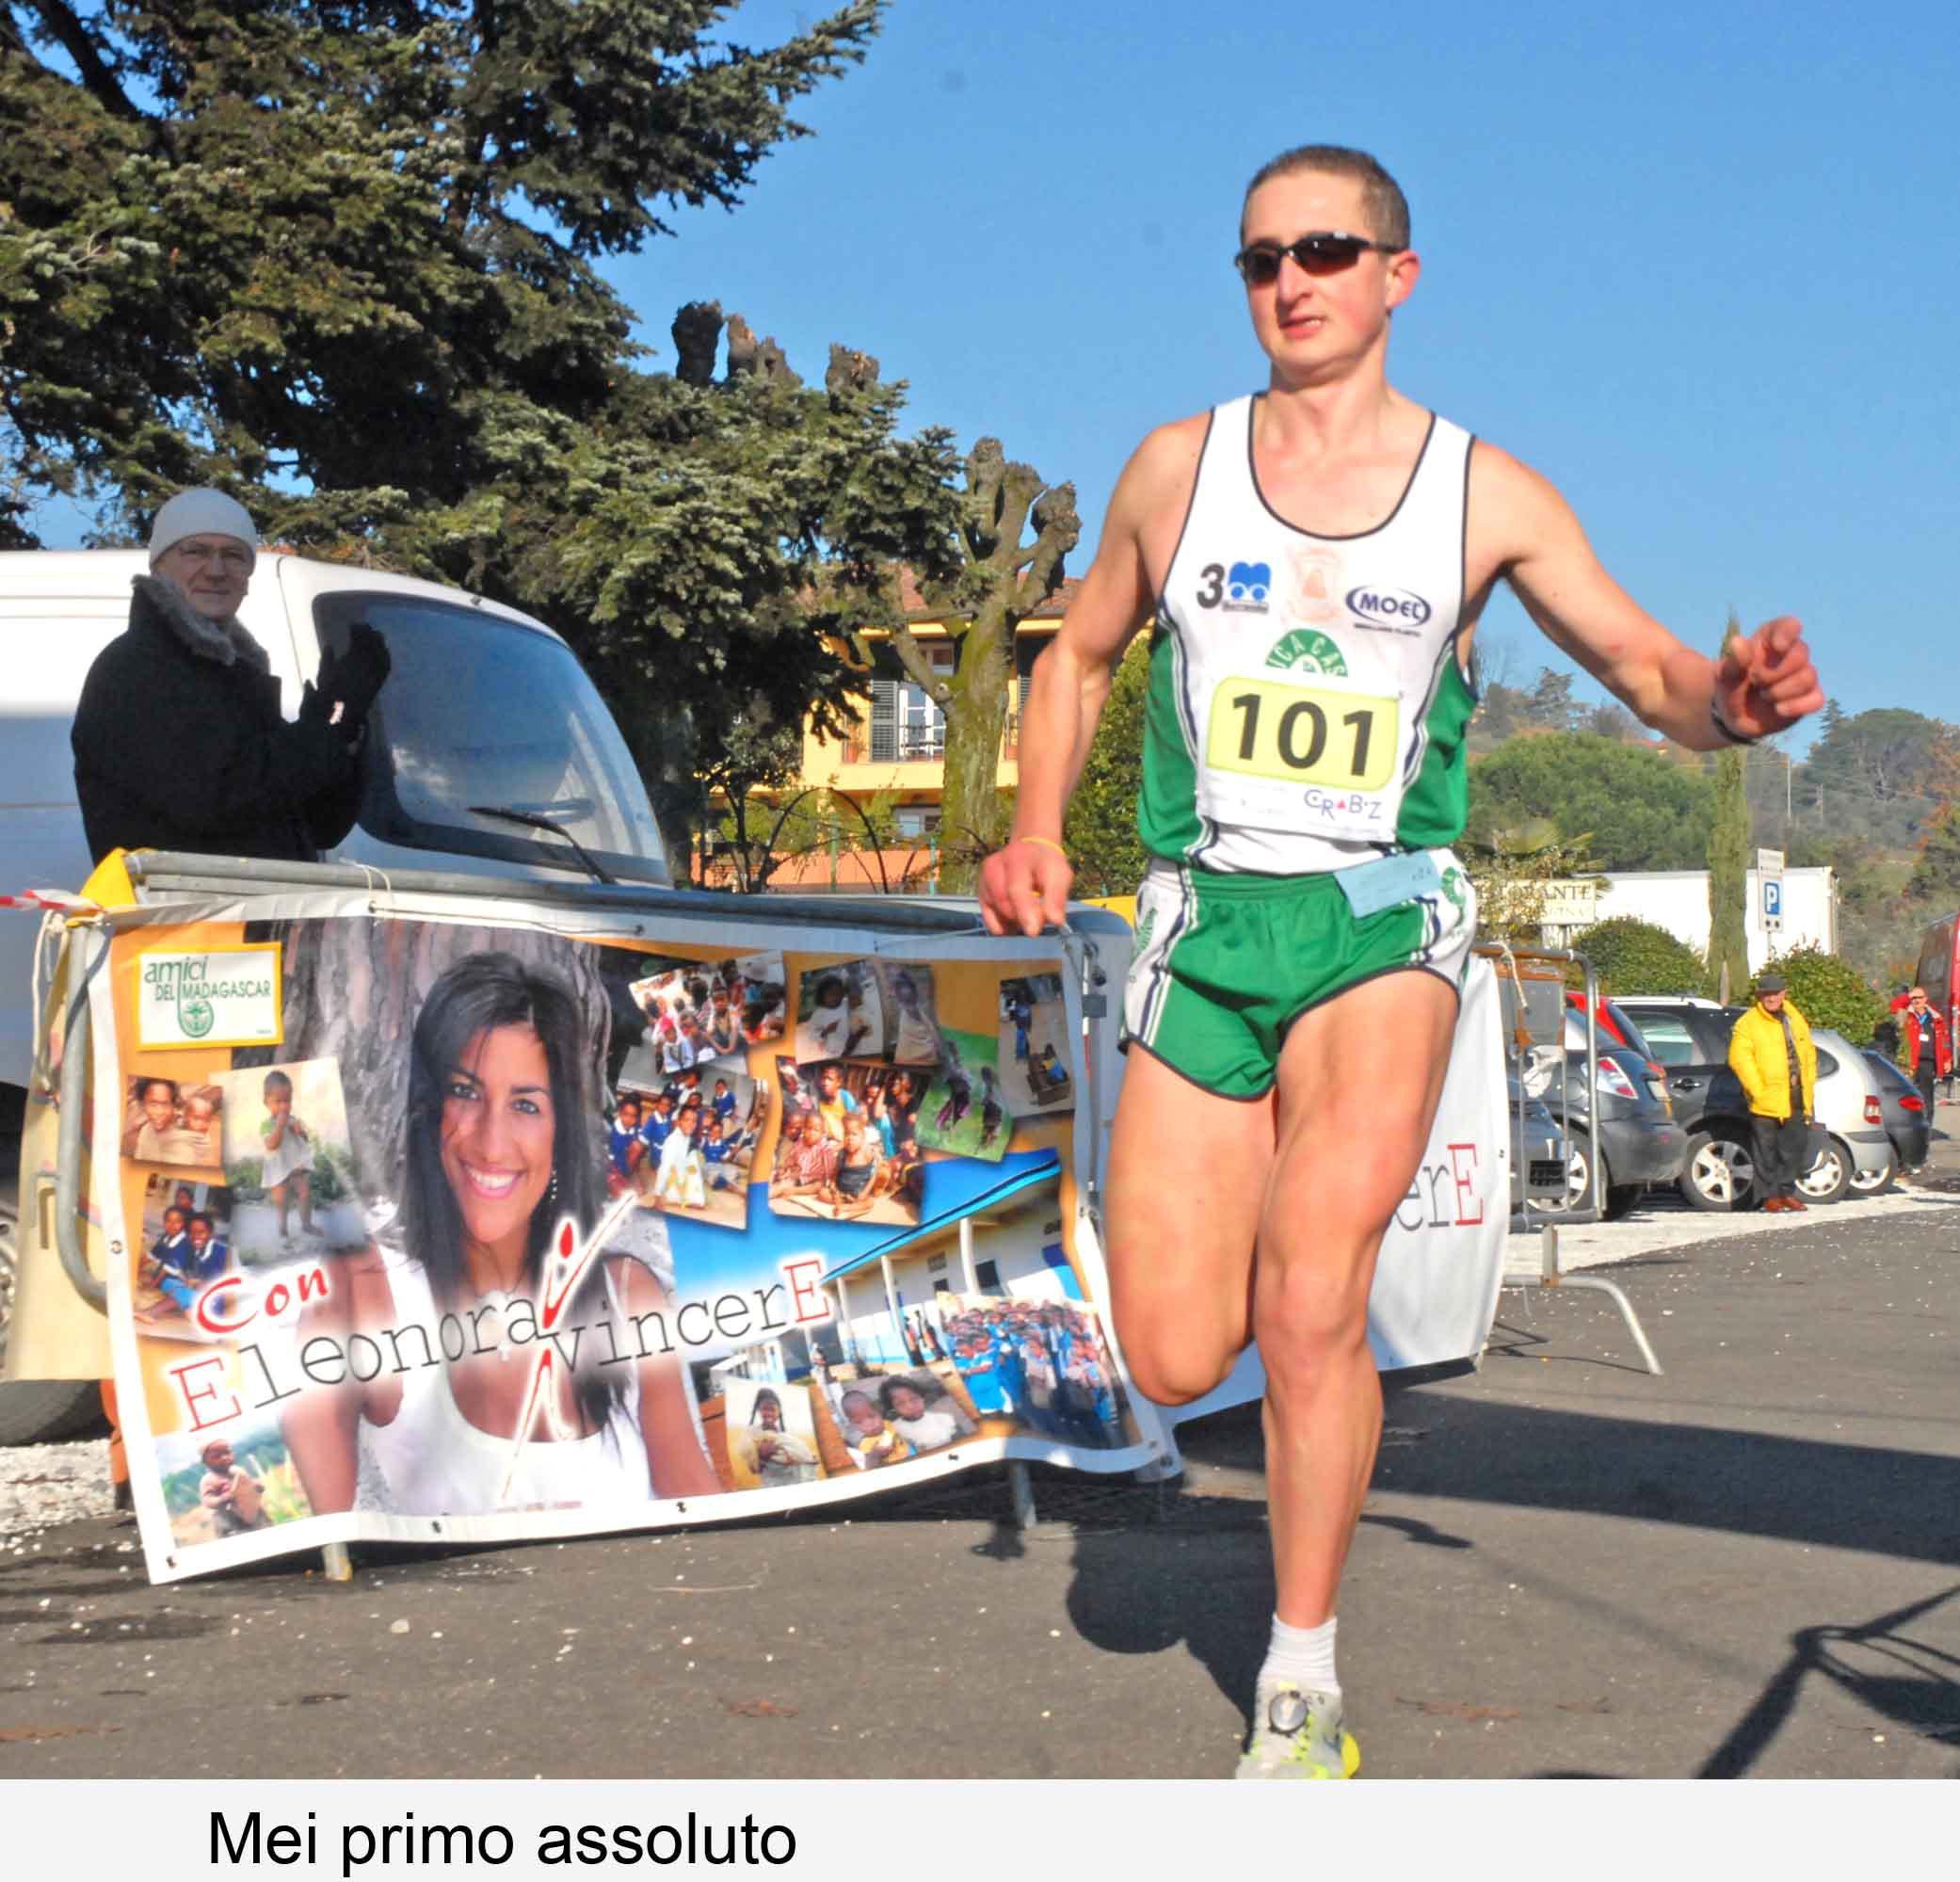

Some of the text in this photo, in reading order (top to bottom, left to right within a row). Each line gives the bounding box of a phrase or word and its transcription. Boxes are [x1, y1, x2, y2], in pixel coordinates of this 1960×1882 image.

[1232, 693, 1374, 777] 101
[1766, 884, 1778, 912] P
[144, 955, 209, 984] amici
[182, 978, 272, 1000] MADAGASCAR
[1395, 1143, 1483, 1231] erE
[197, 1266, 329, 1334] Con
[169, 1259, 830, 1432] Eleonora vincerE
